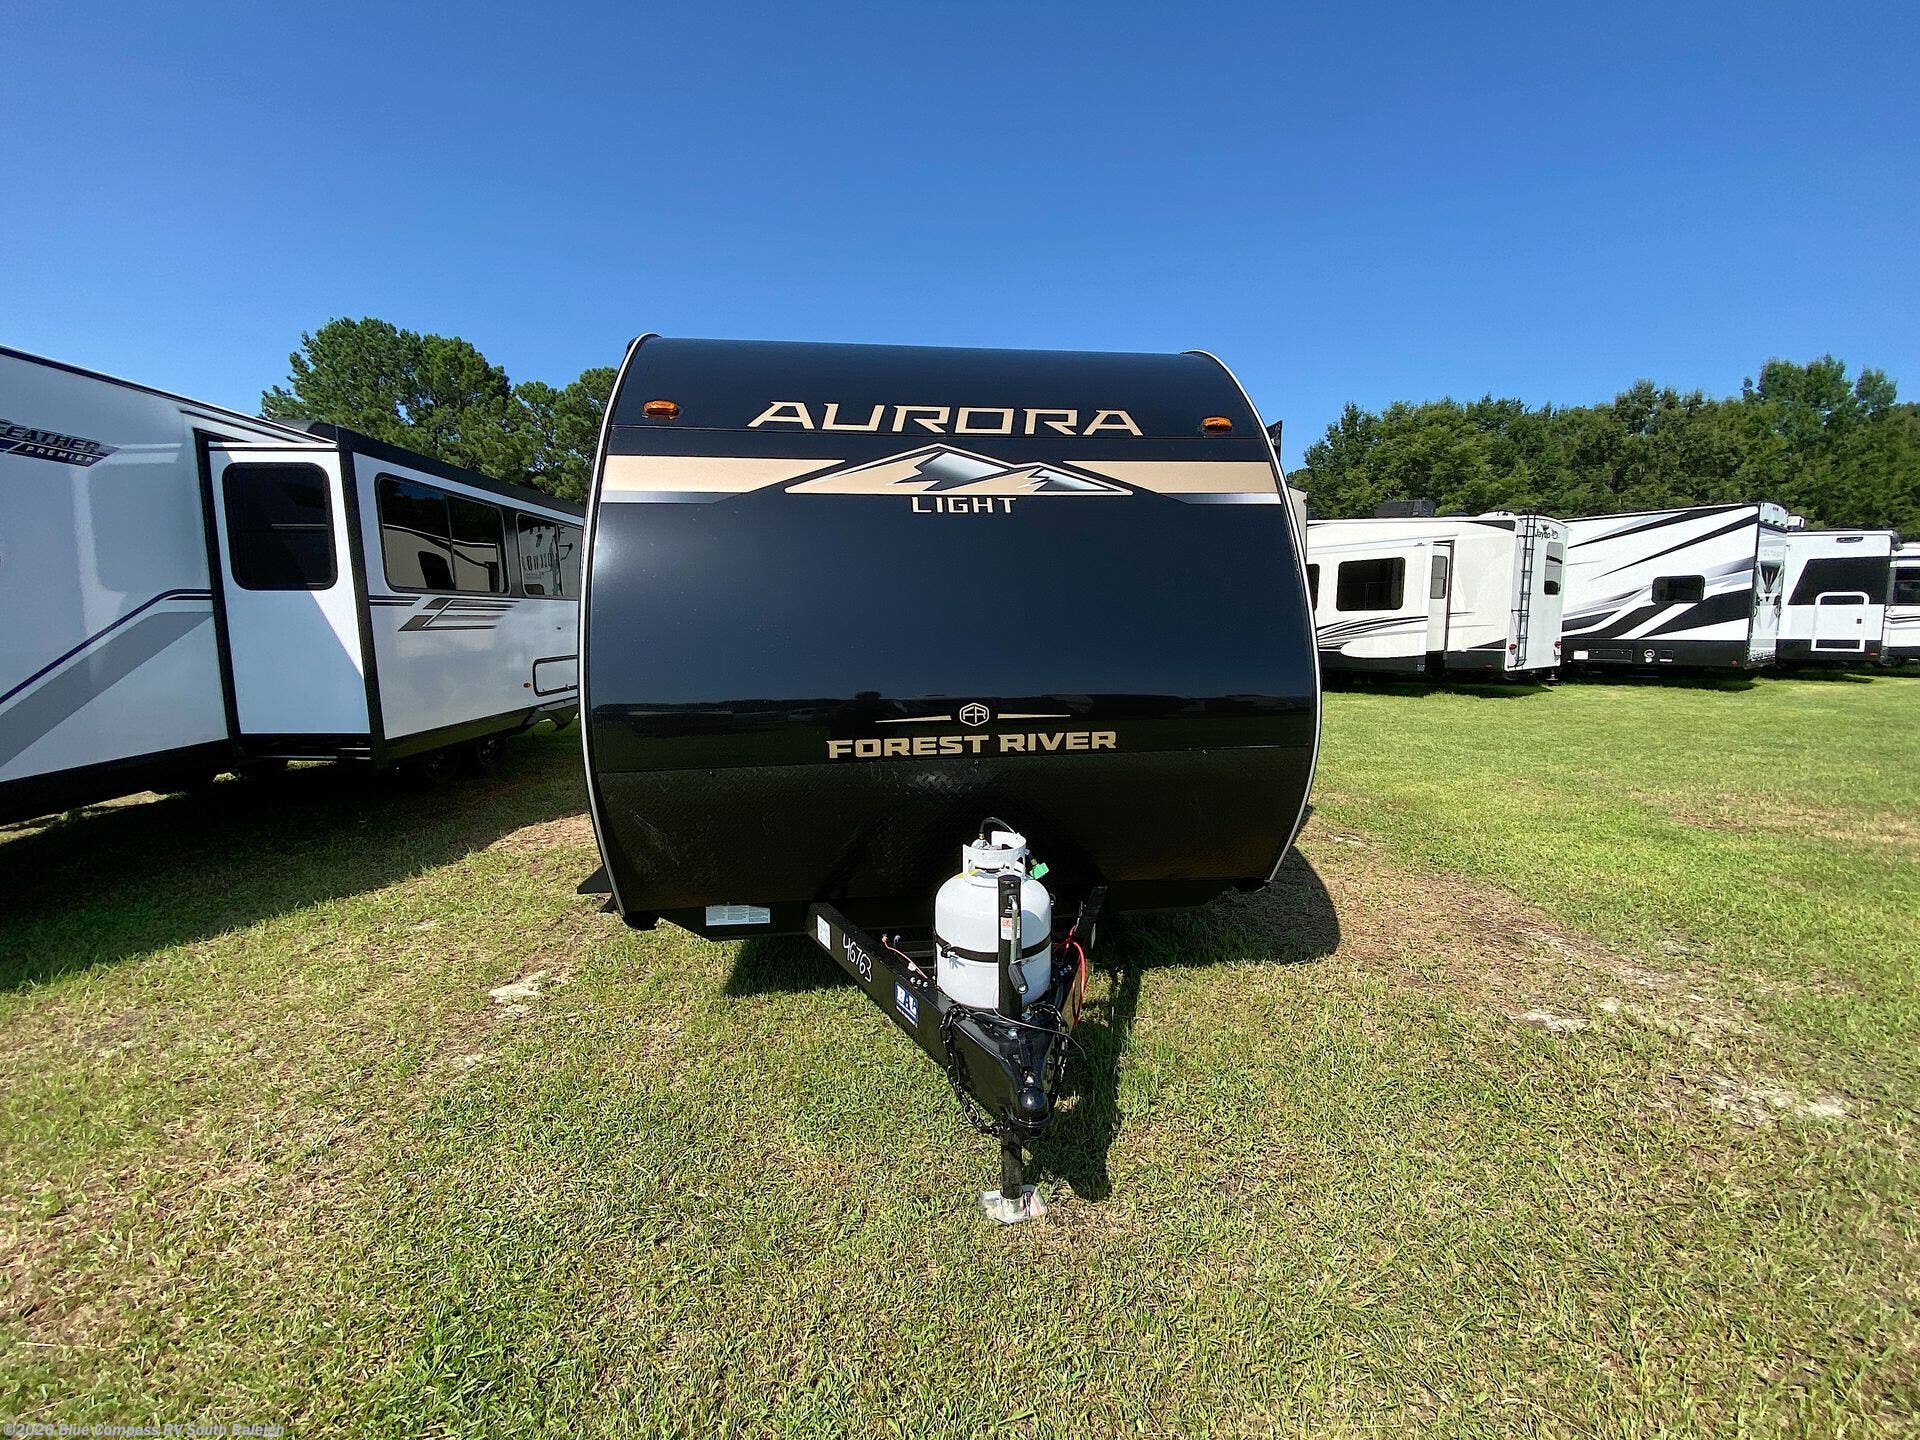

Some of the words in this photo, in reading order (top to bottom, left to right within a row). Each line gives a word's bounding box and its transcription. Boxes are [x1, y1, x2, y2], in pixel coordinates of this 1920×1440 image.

[747, 401, 1143, 436] AURORA
[25, 446, 93, 462] PREMIER
[911, 497, 1017, 514] LIGHT
[826, 735, 990, 759] FOREST
[998, 731, 1117, 752] RIVER
[842, 933, 872, 983] 46763
